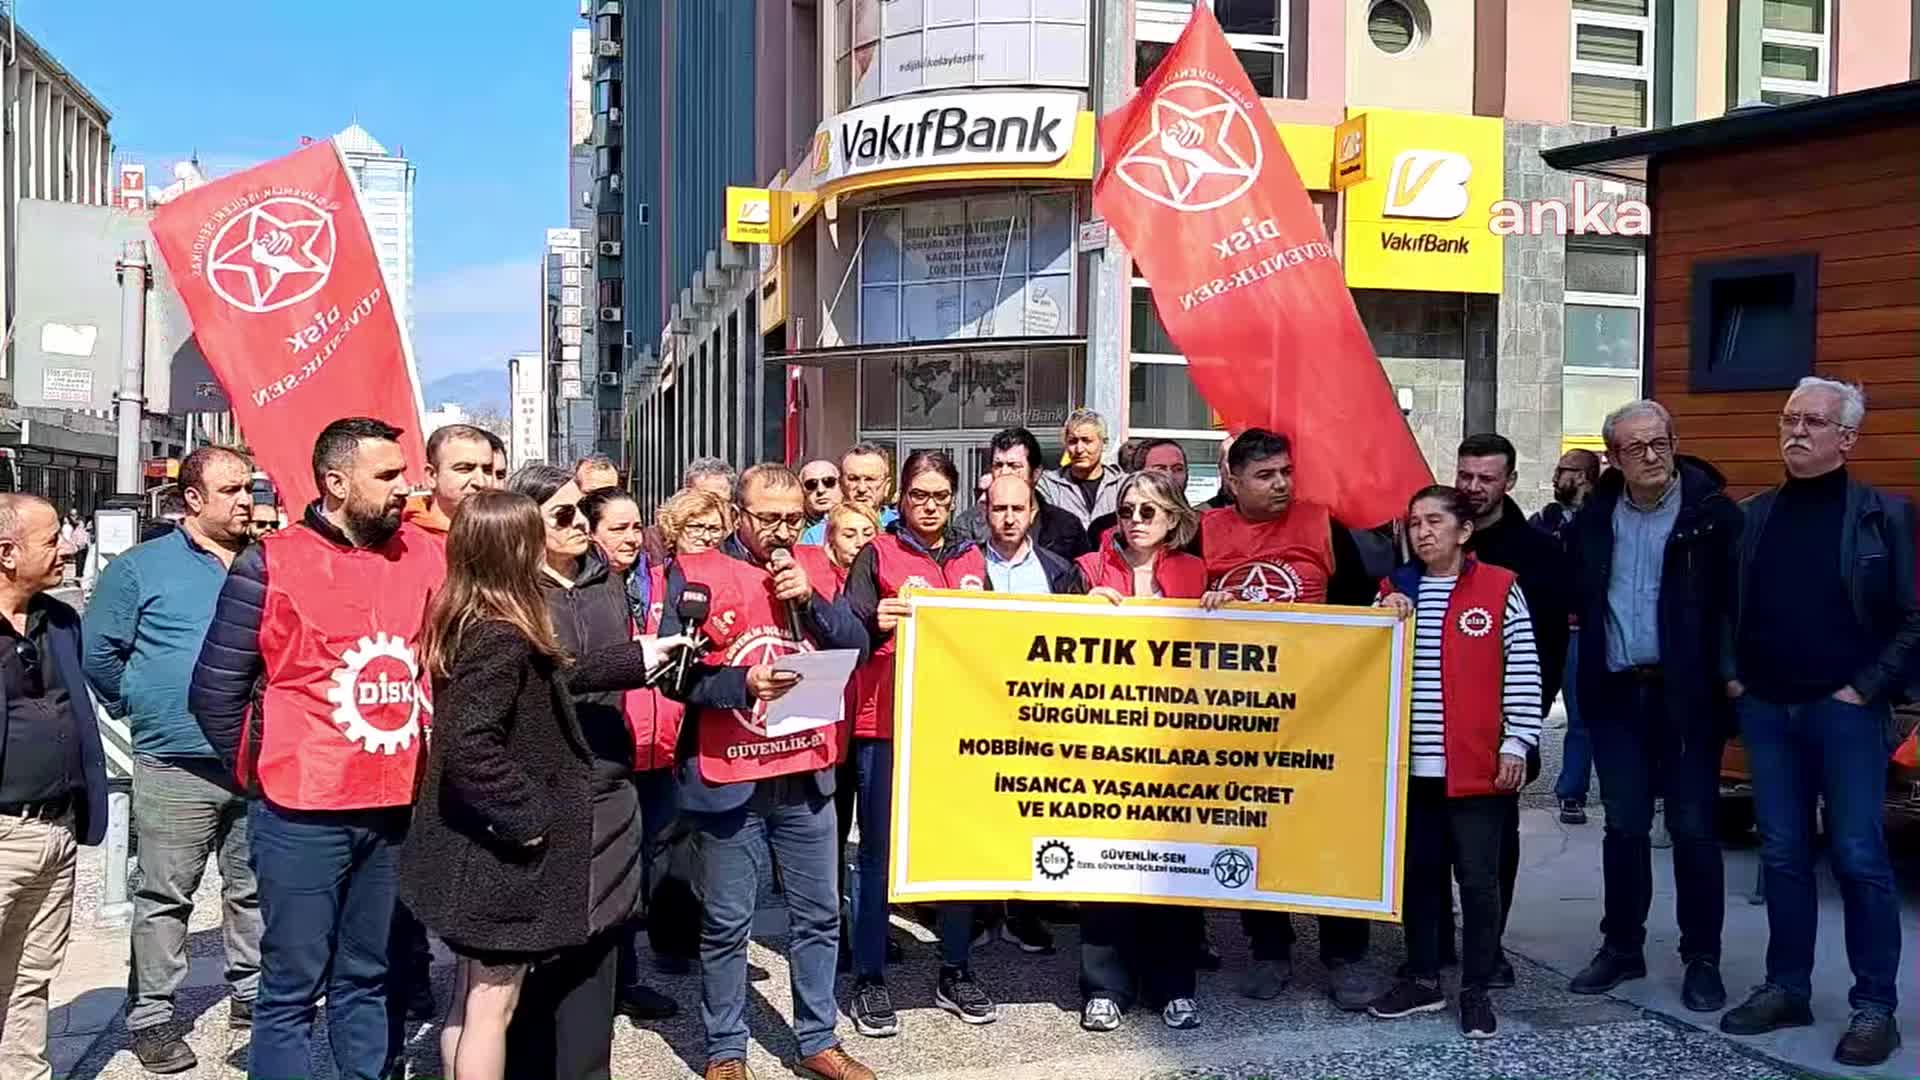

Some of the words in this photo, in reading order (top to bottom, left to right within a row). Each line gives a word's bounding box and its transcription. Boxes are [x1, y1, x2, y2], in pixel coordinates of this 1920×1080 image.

[841, 106, 1062, 165] VakıfBank
[1381, 231, 1469, 255] VakıfBank
[1003, 407, 1067, 422] VakfBank
[1027, 635, 1137, 666] ARTIK
[1147, 640, 1278, 672] YETER!
[358, 672, 415, 704] DİSK
[1006, 678, 1065, 699] TAYİN
[1069, 683, 1105, 700] ADI
[1110, 685, 1199, 704] ALTINDA
[1204, 689, 1296, 710] YAPILAN
[1018, 703, 1148, 726] SÜRGÜNLERİ
[1154, 711, 1280, 732] DURDURUN!
[959, 737, 1054, 757] MOBBİNG
[1060, 744, 1087, 759] VE
[1092, 746, 1210, 766] BASKILARA
[1215, 750, 1259, 767] SON
[1264, 749, 1335, 770] VERİN!
[994, 773, 1086, 794] İNSANCA
[1093, 779, 1220, 801] YAŞANACAK
[1225, 782, 1294, 805] ÜCRET
[1018, 801, 1044, 817] VE
[1050, 801, 1121, 819] KADRO
[1126, 805, 1191, 823] HAKKI
[1197, 806, 1268, 828] VERİN!
[1101, 848, 1186, 864] GÜVENLİK-SEN
